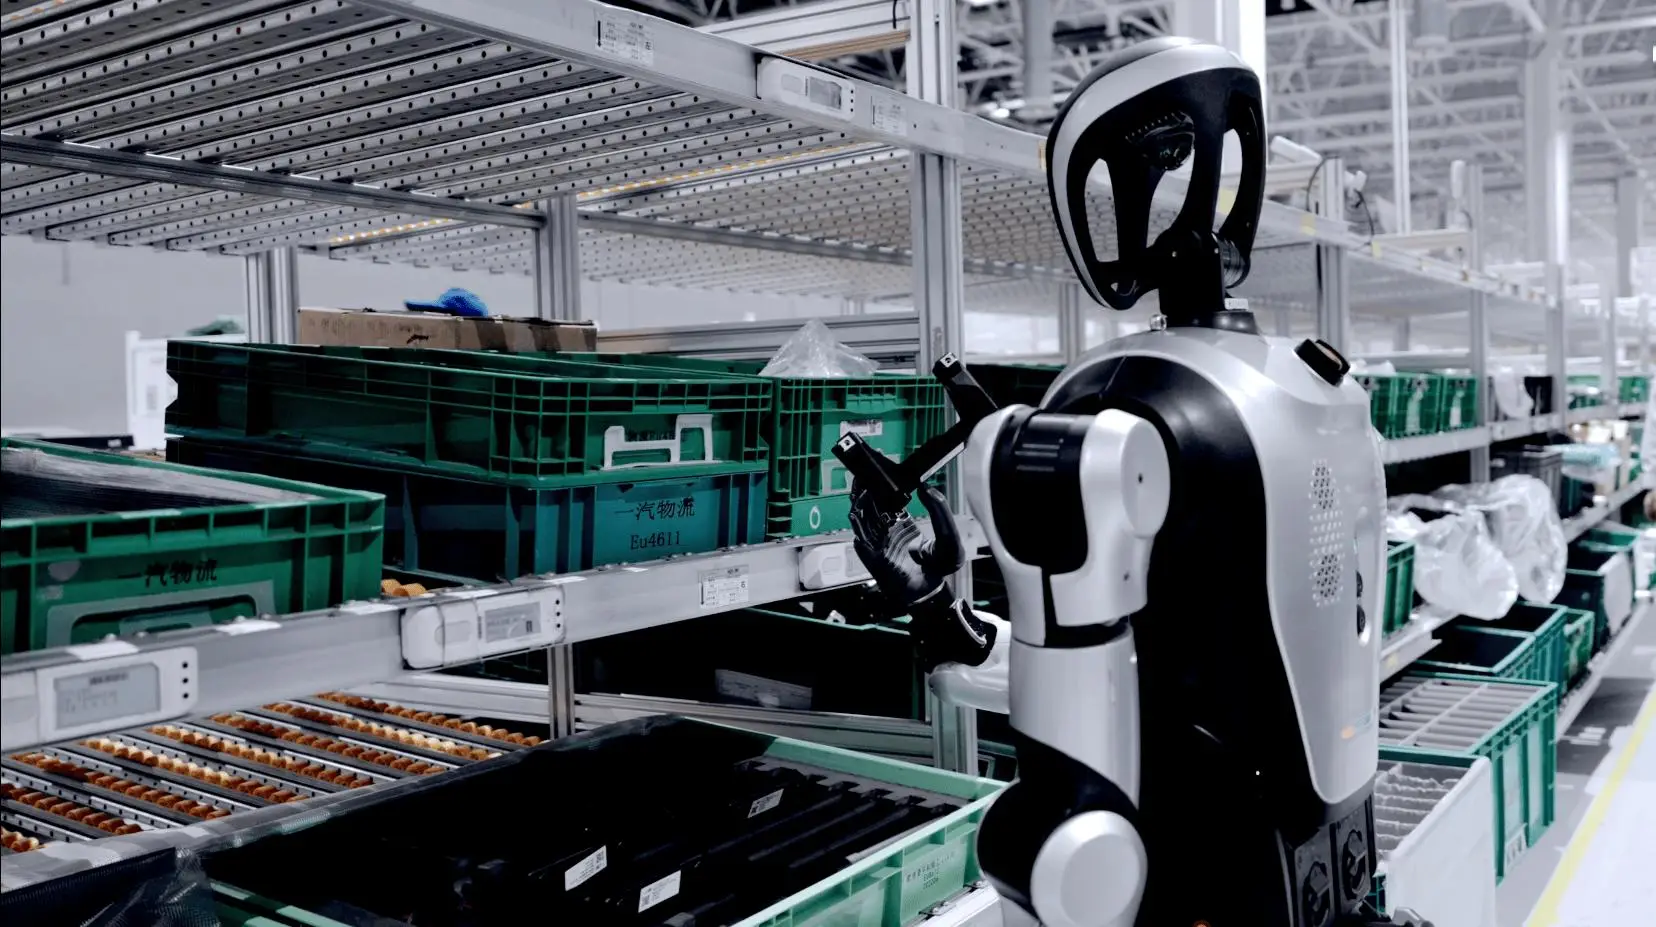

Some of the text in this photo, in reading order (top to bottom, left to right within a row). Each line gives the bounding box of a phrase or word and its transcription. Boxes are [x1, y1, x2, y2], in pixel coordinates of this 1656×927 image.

[614, 496, 695, 520] 一汽物流
[630, 531, 680, 550] Eu4611
[118, 559, 217, 588] 一汽物流
